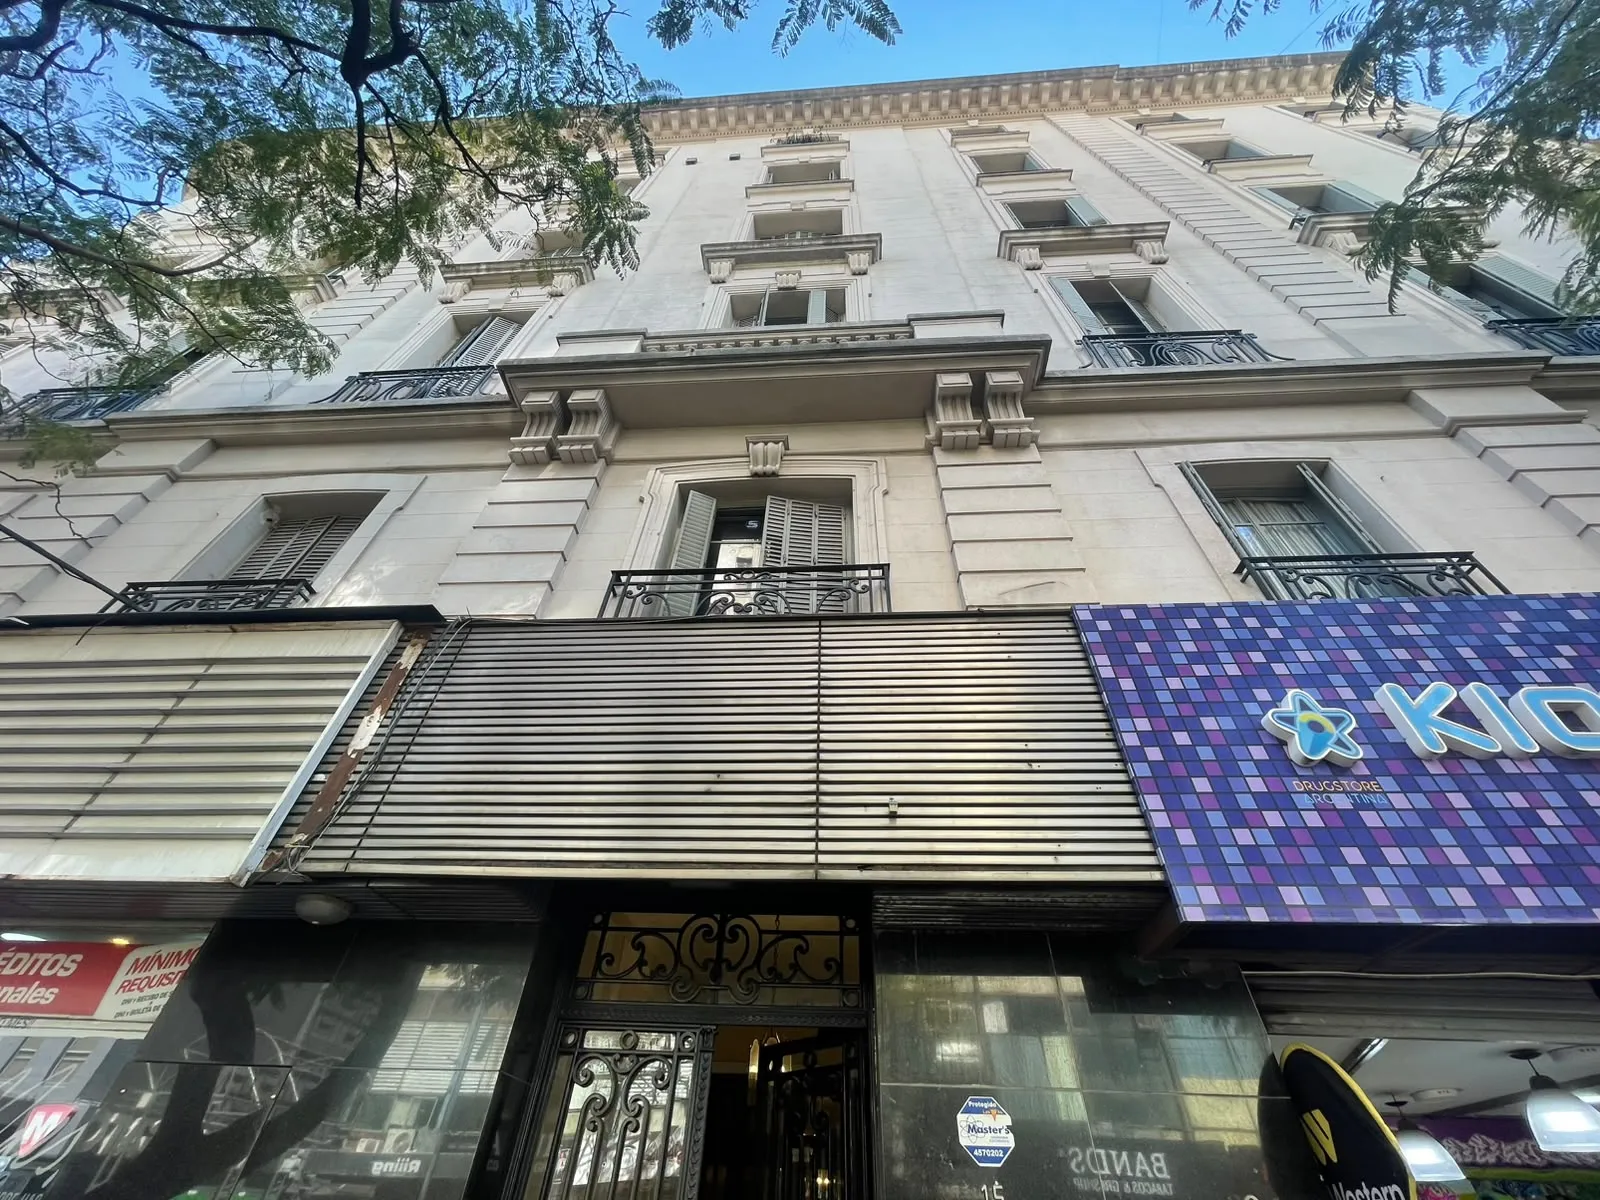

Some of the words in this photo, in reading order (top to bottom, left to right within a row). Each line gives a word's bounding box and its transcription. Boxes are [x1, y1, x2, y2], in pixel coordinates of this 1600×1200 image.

[1292, 780, 1383, 792] DRUGSTORE
[1304, 793, 1388, 804] ARGTINA
[967, 1124, 1010, 1135] Master's
[973, 1148, 1004, 1157] 4570202
